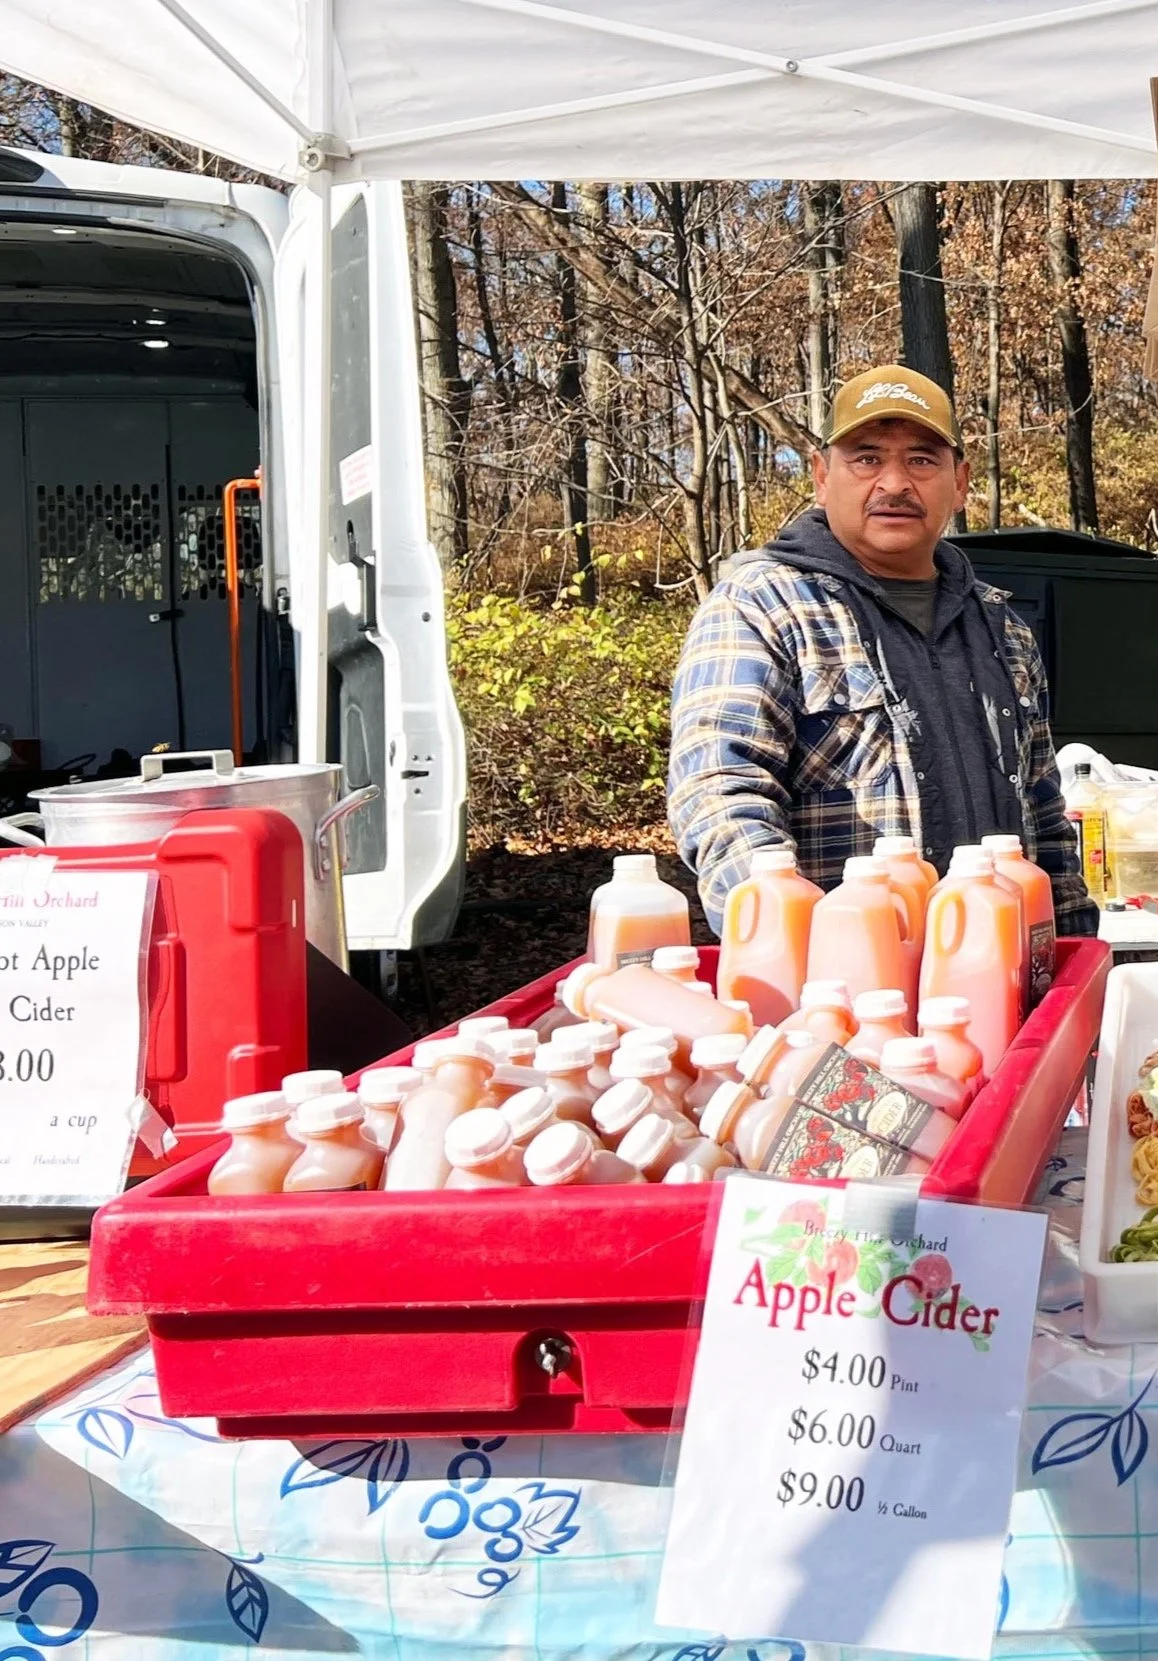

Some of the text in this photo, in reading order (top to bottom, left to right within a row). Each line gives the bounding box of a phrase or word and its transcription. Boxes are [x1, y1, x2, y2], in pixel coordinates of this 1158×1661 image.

[34, 890, 99, 908] Orchard
[19, 919, 48, 928] VALLEY
[31, 943, 100, 981] Apple
[9, 994, 75, 1022] Cider
[50, 1115, 97, 1135] a cup
[733, 1258, 999, 1335] Apple Cider
[802, 1347, 919, 1392] $4.00 Pint
[788, 1406, 921, 1455] $6.00 Quart
[776, 1468, 865, 1512] $9.00
